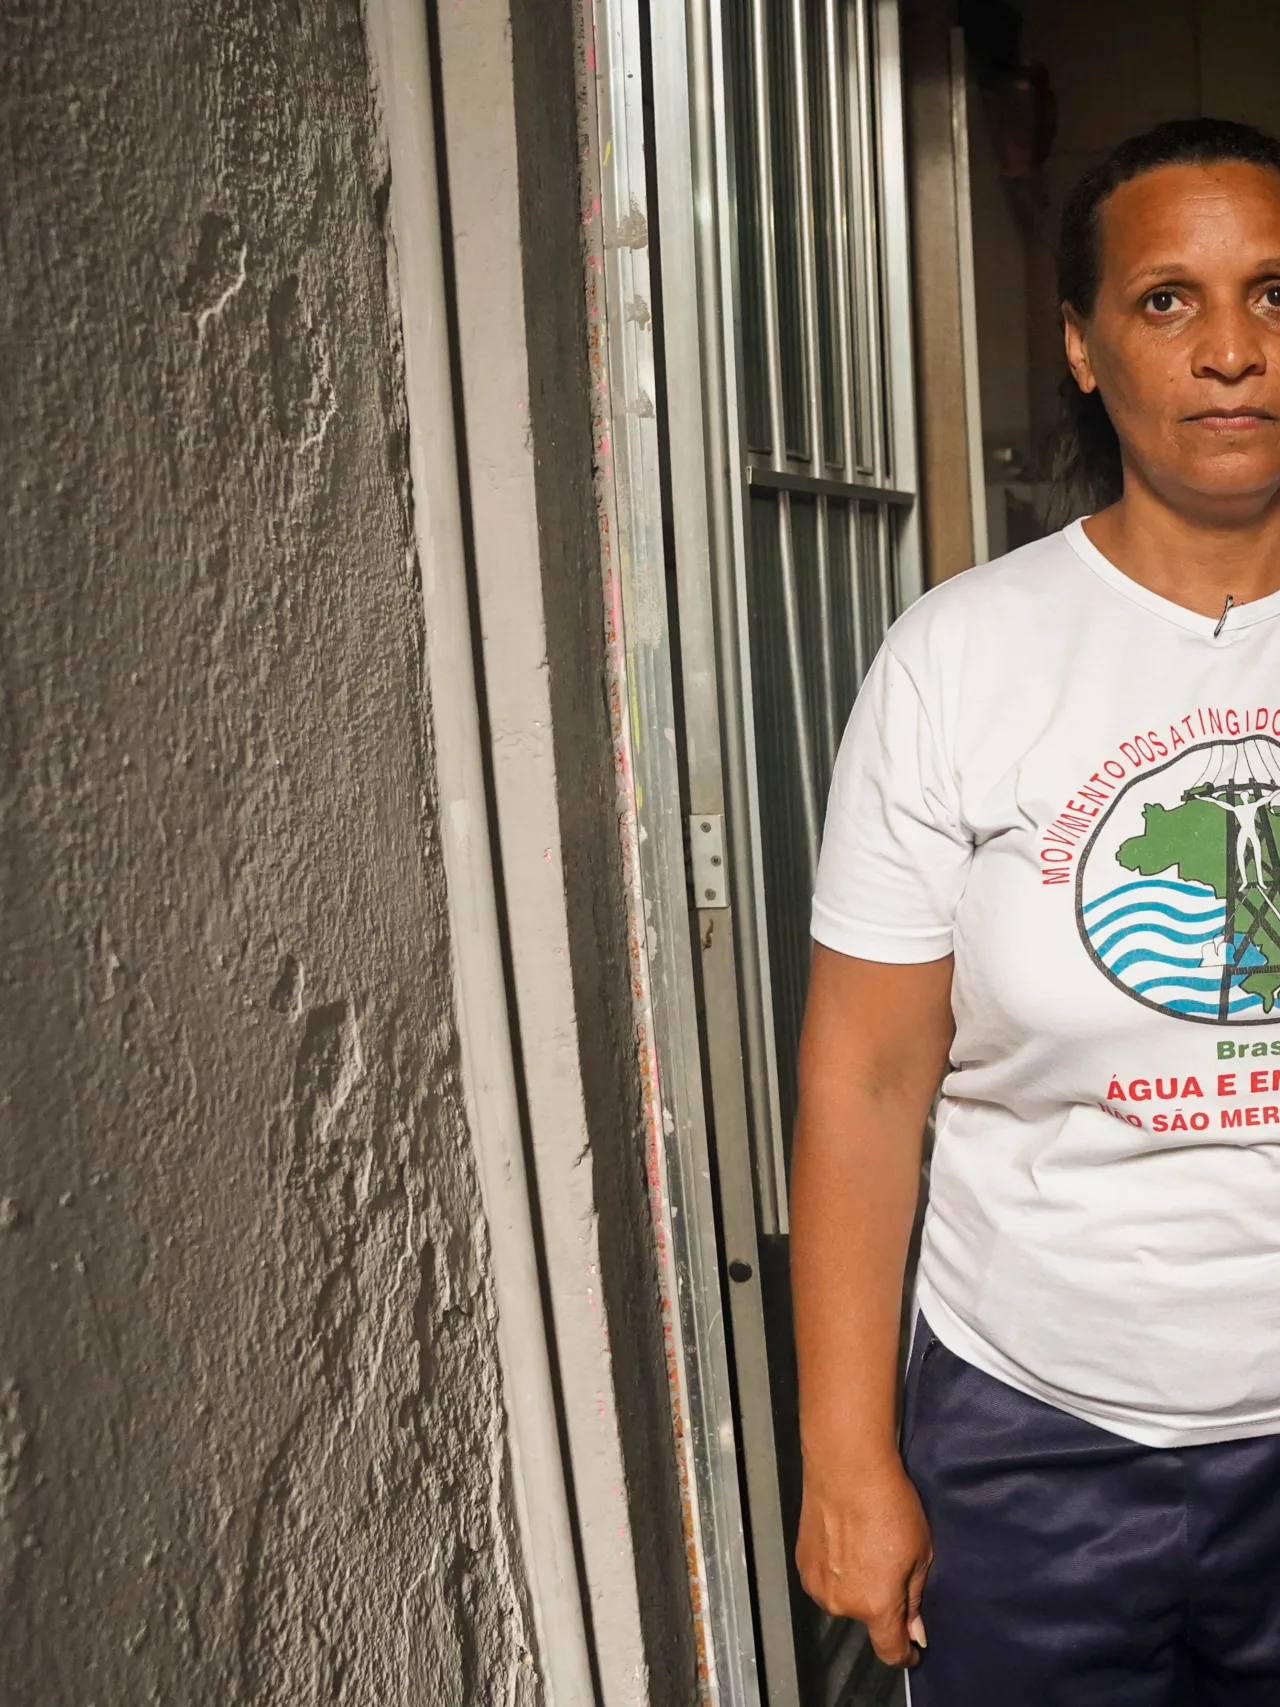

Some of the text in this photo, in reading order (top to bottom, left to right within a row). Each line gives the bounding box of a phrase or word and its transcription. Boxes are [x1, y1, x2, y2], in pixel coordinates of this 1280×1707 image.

[1041, 760, 1126, 886] MOVIMENTO
[1119, 731, 1170, 768] DOS
[1106, 1074, 1204, 1102] ÁGUA
[1217, 1073, 1237, 1097] E
[1152, 1108, 1210, 1132] SÃO
